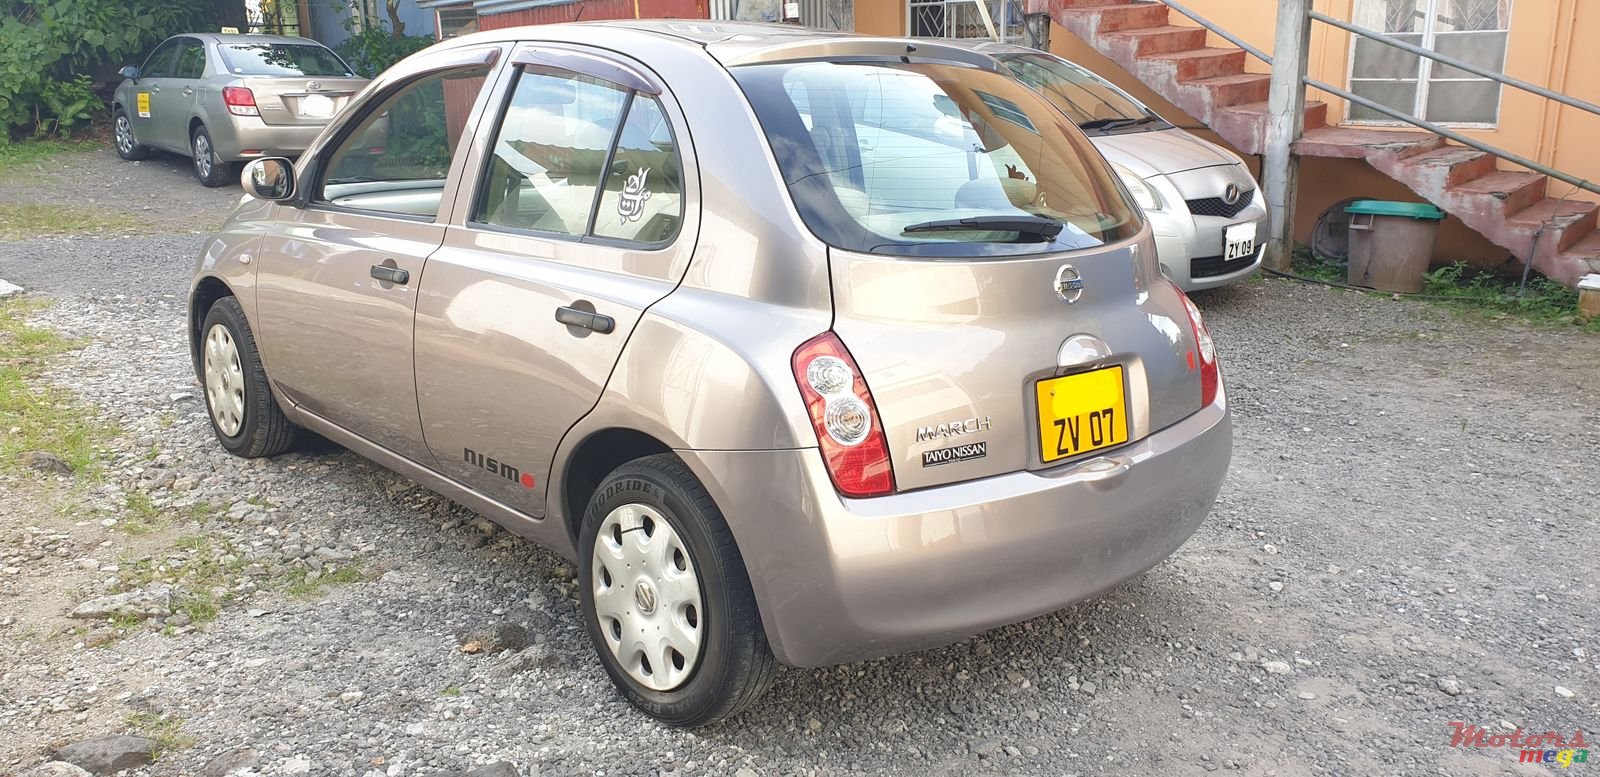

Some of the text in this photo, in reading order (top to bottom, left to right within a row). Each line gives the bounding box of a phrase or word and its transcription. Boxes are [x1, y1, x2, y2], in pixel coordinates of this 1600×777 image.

[1229, 240, 1252, 259] ZY 09
[915, 416, 992, 442] MARCH
[1054, 408, 1114, 456] ZV 07
[924, 449, 951, 463] TAIYO
[952, 443, 985, 458] NISSAN
[586, 479, 652, 528] GOODRIDE
